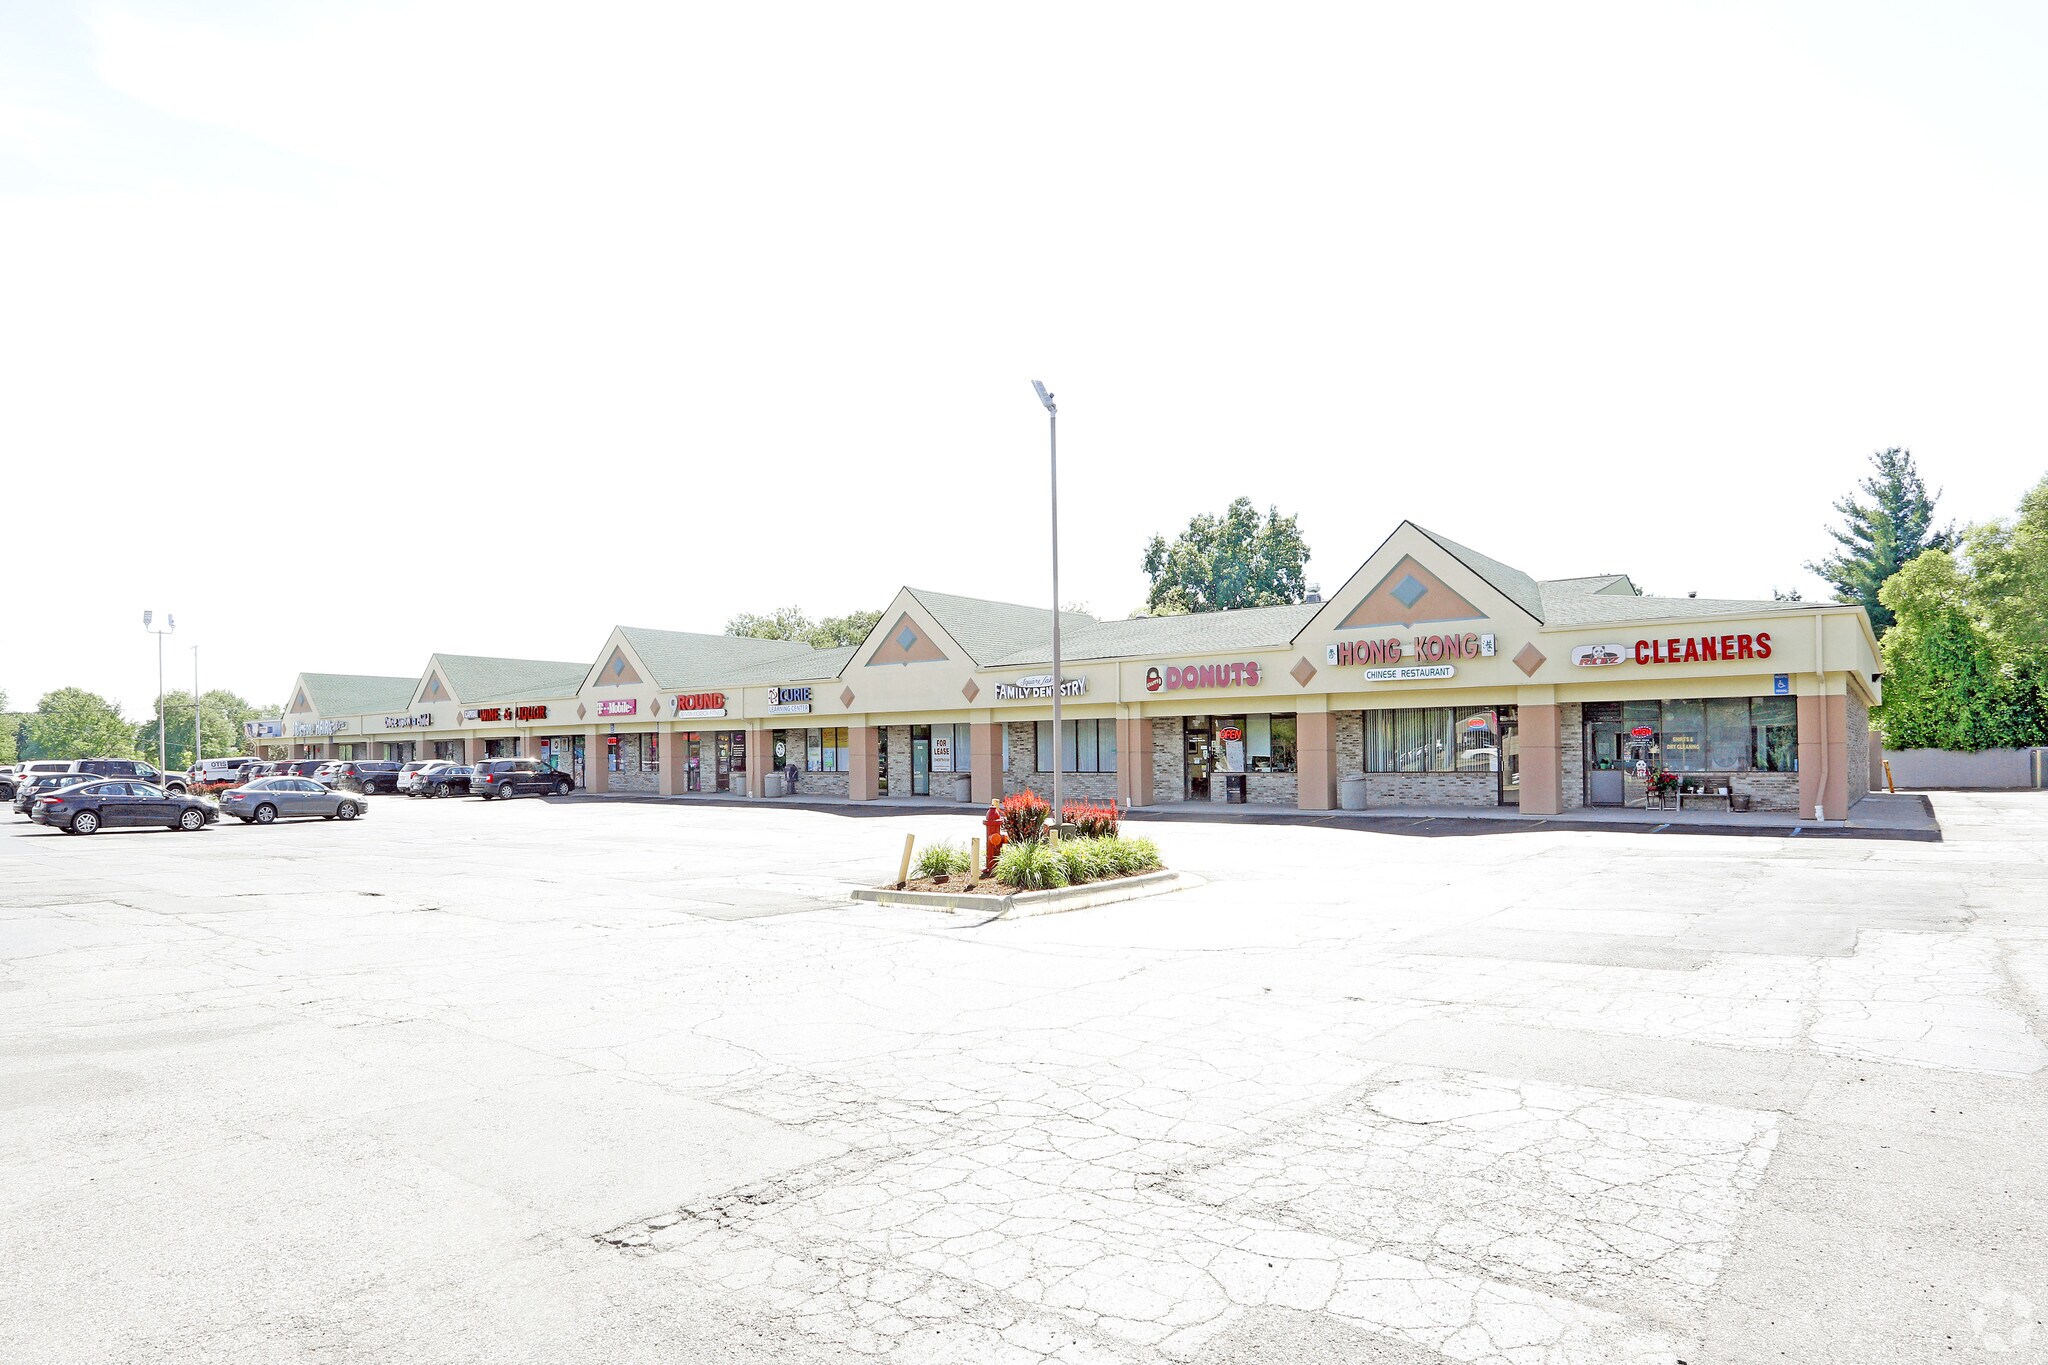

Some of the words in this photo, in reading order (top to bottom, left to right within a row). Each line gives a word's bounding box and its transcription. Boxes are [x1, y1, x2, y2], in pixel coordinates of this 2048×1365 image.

[1339, 637, 1402, 666] HONG
[1414, 632, 1479, 662] KONG
[1634, 632, 1772, 665] CLEANERS
[1166, 661, 1260, 690] DONUTS
[1366, 669, 1397, 680] CHINESE
[1401, 667, 1450, 678] RESTAURANT
[780, 687, 811, 702] CURIE
[994, 682, 1030, 700] FAMILY
[1033, 674, 1087, 698] DENSTRY
[480, 707, 501, 722] WINE
[504, 707, 512, 721] &
[515, 705, 547, 722] LIQUOR
[1219, 729, 1242, 740] OPEN
[933, 747, 950, 755] LEASE
[936, 739, 946, 747] FOR
